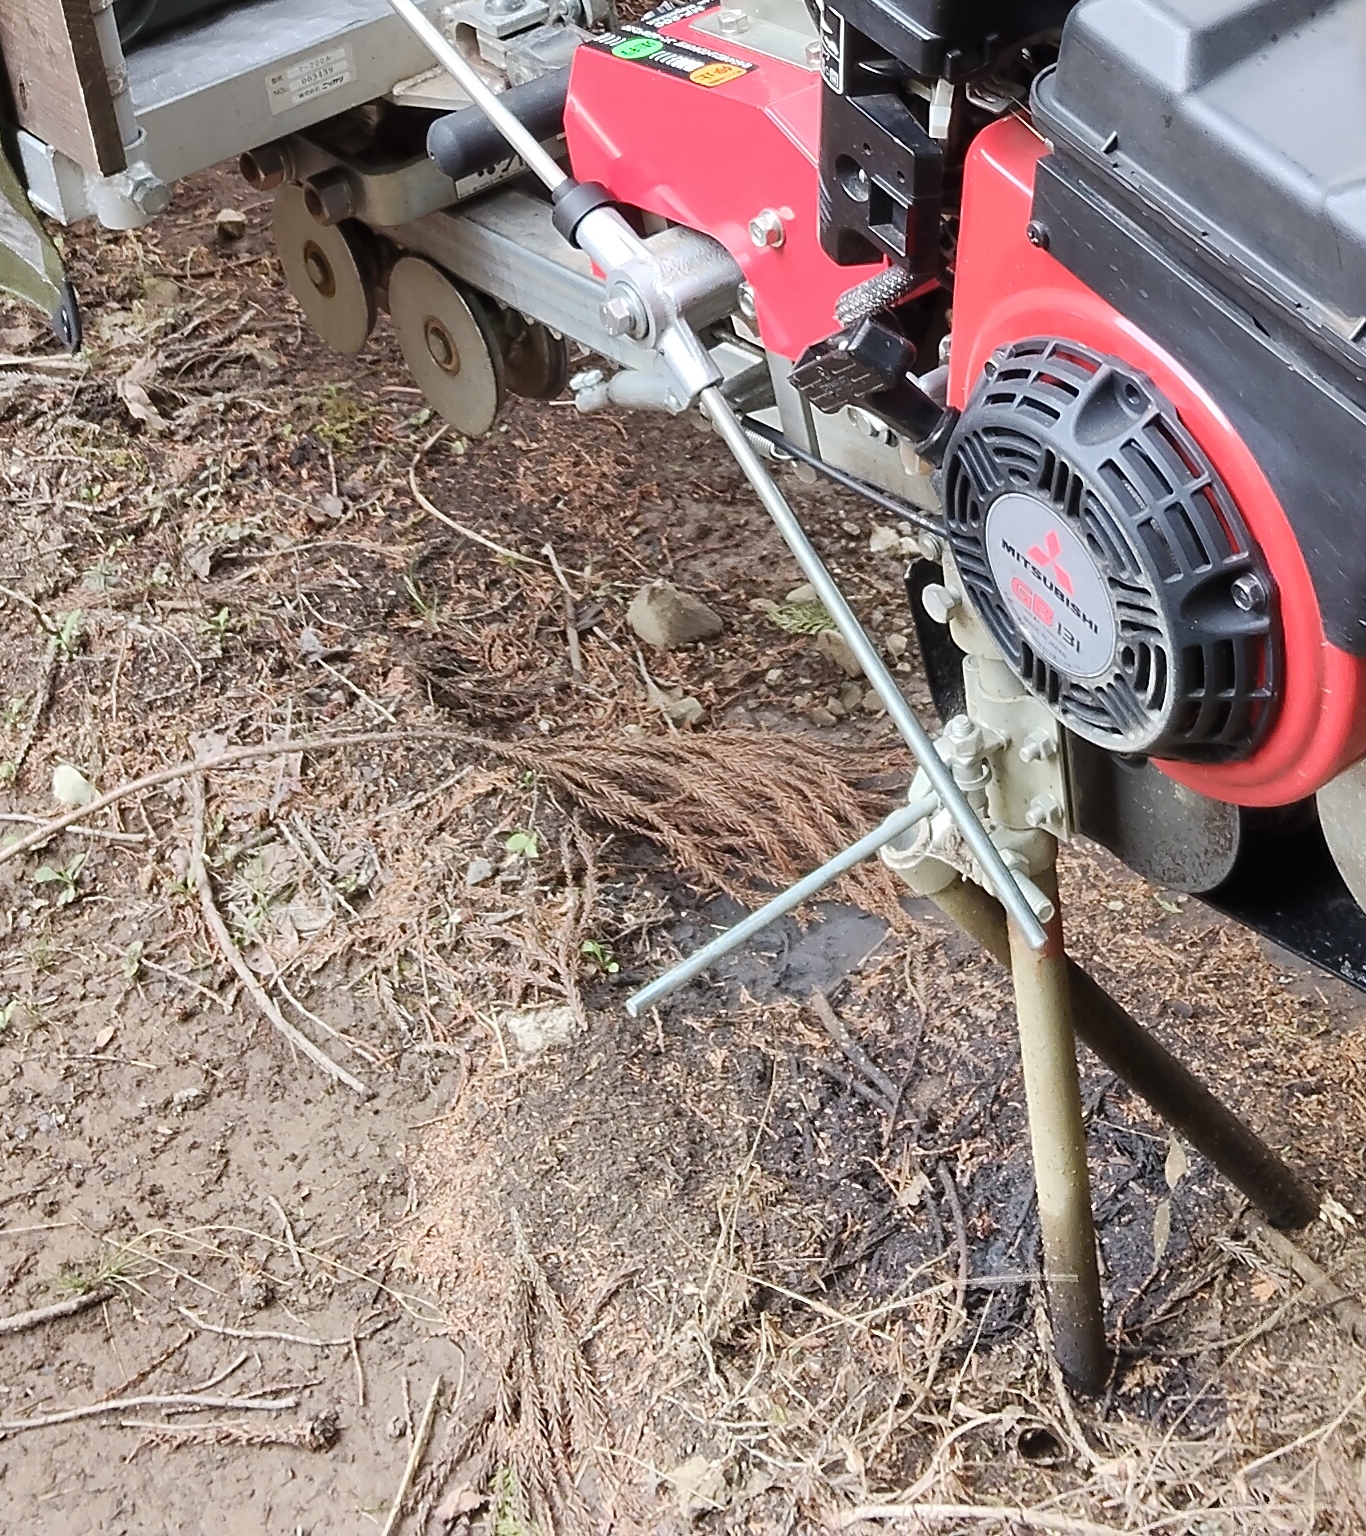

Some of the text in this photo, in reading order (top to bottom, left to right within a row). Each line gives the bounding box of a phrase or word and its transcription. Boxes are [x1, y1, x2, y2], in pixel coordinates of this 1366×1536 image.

[1001, 538, 1099, 635] MITSUBISHI
[1011, 576, 1054, 626] GB
[1057, 622, 1080, 653] 131
